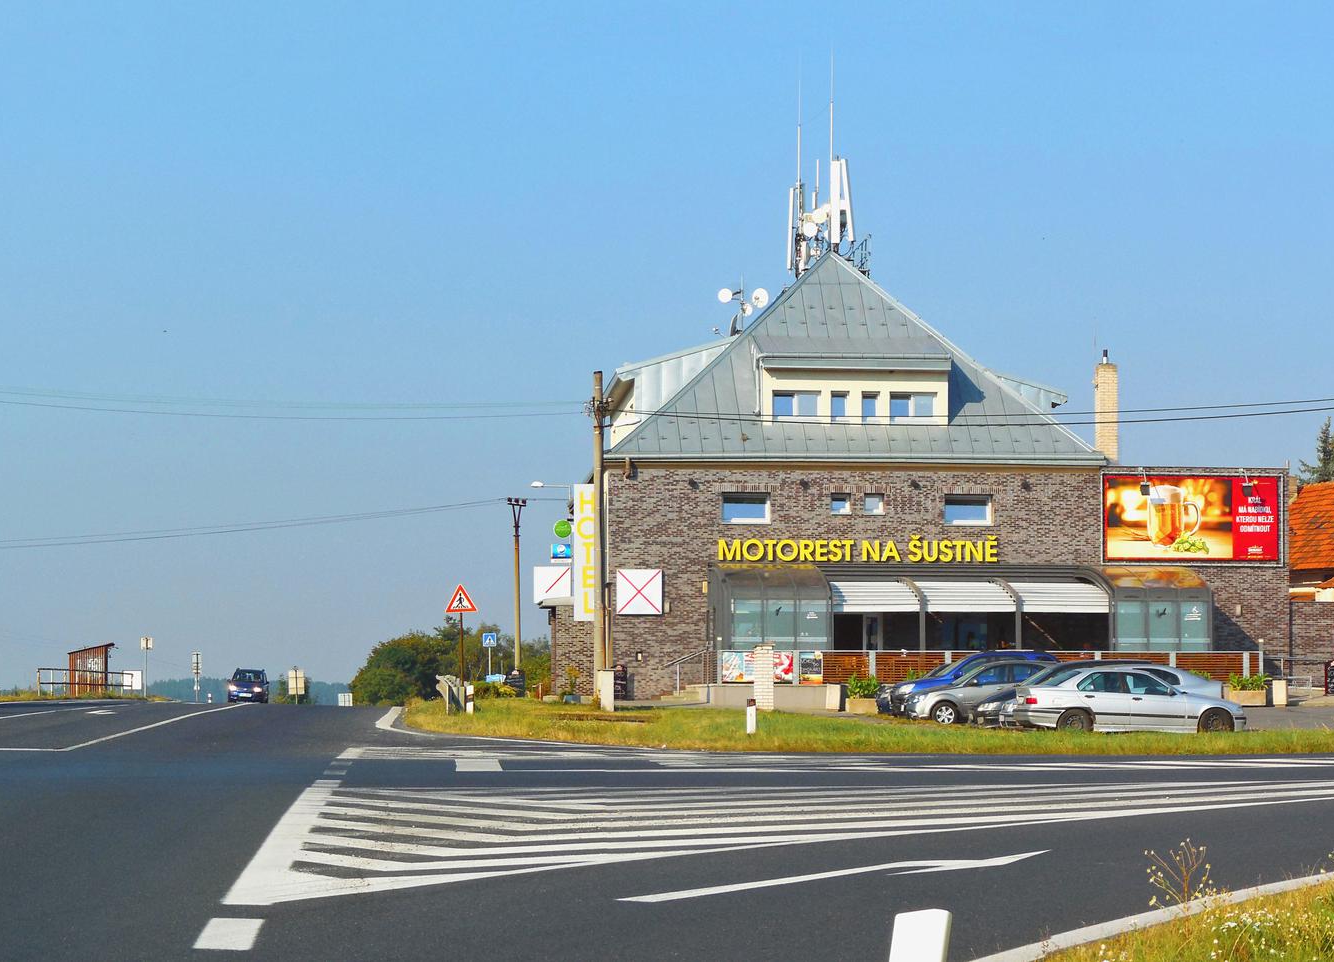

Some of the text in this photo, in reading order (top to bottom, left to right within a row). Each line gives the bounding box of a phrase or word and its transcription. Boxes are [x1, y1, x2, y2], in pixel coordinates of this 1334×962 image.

[1236, 515, 1274, 523] KTEROU NELZE
[576, 491, 595, 614] HOTEL
[718, 535, 999, 562] MOTOREST NA ŠUSTNĚ
